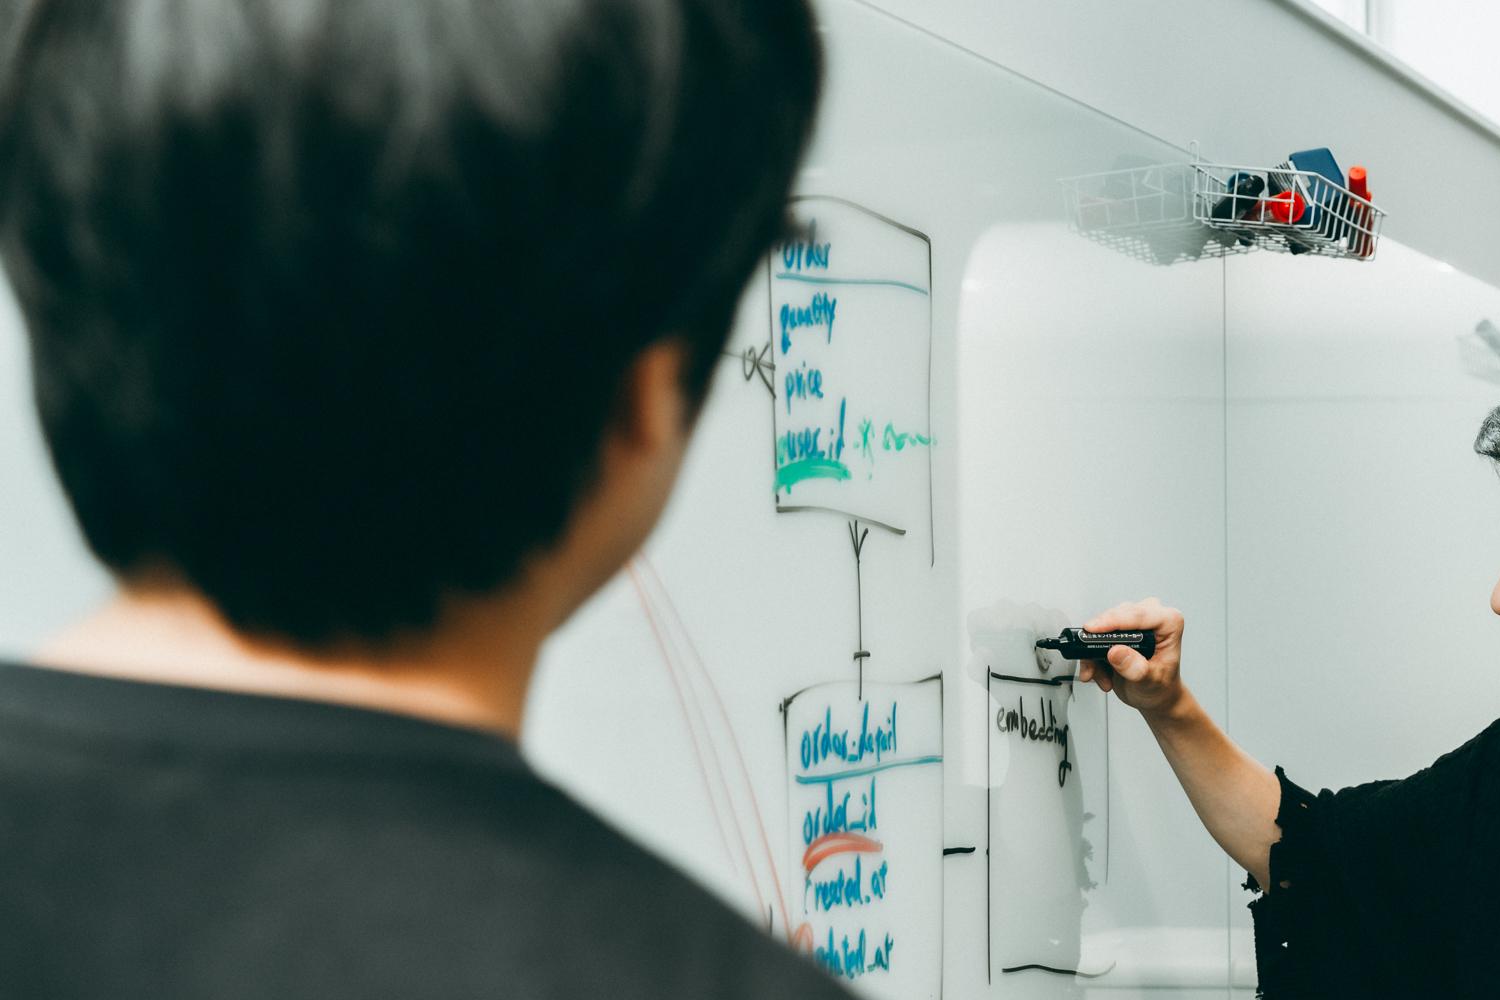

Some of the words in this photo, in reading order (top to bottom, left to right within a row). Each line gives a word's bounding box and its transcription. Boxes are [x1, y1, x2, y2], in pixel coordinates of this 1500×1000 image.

[786, 361, 823, 415] price
[997, 695, 1072, 788] embedding
[803, 776, 875, 845] order_id
